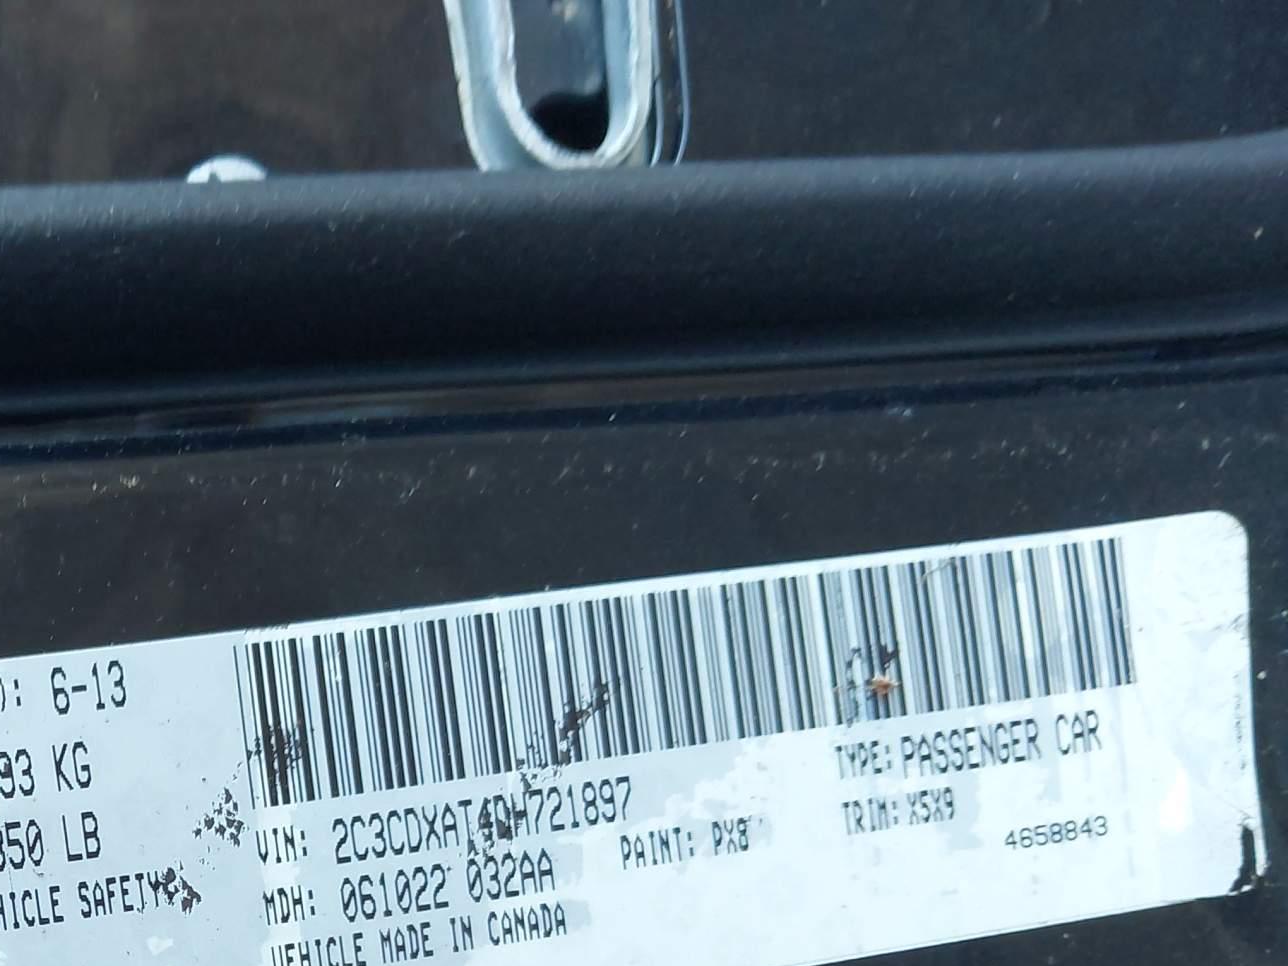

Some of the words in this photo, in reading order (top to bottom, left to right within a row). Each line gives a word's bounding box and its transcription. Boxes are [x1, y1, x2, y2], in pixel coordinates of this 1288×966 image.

[51, 661, 128, 715] 6-13
[52, 741, 92, 791] KG
[835, 739, 893, 780] TYPE:
[900, 718, 1042, 778] PASSENGER
[1055, 709, 1103, 755] CAR
[62, 811, 101, 862] LB
[255, 825, 308, 864] VIN:
[332, 776, 631, 865] 2C3CDXAT4DH721897
[841, 799, 900, 835] TRIM:
[907, 787, 954, 825] X5X9
[1005, 815, 1108, 850] 4658843
[620, 827, 695, 869] PAINT:
[712, 823, 749, 855] PX8
[78, 871, 162, 918] SAFETY
[262, 884, 315, 926] MDH:
[340, 862, 450, 922] 061022
[466, 848, 556, 902] 032AA
[380, 921, 434, 965] MADE
[449, 915, 475, 953] IN
[487, 902, 567, 946] CANADA
